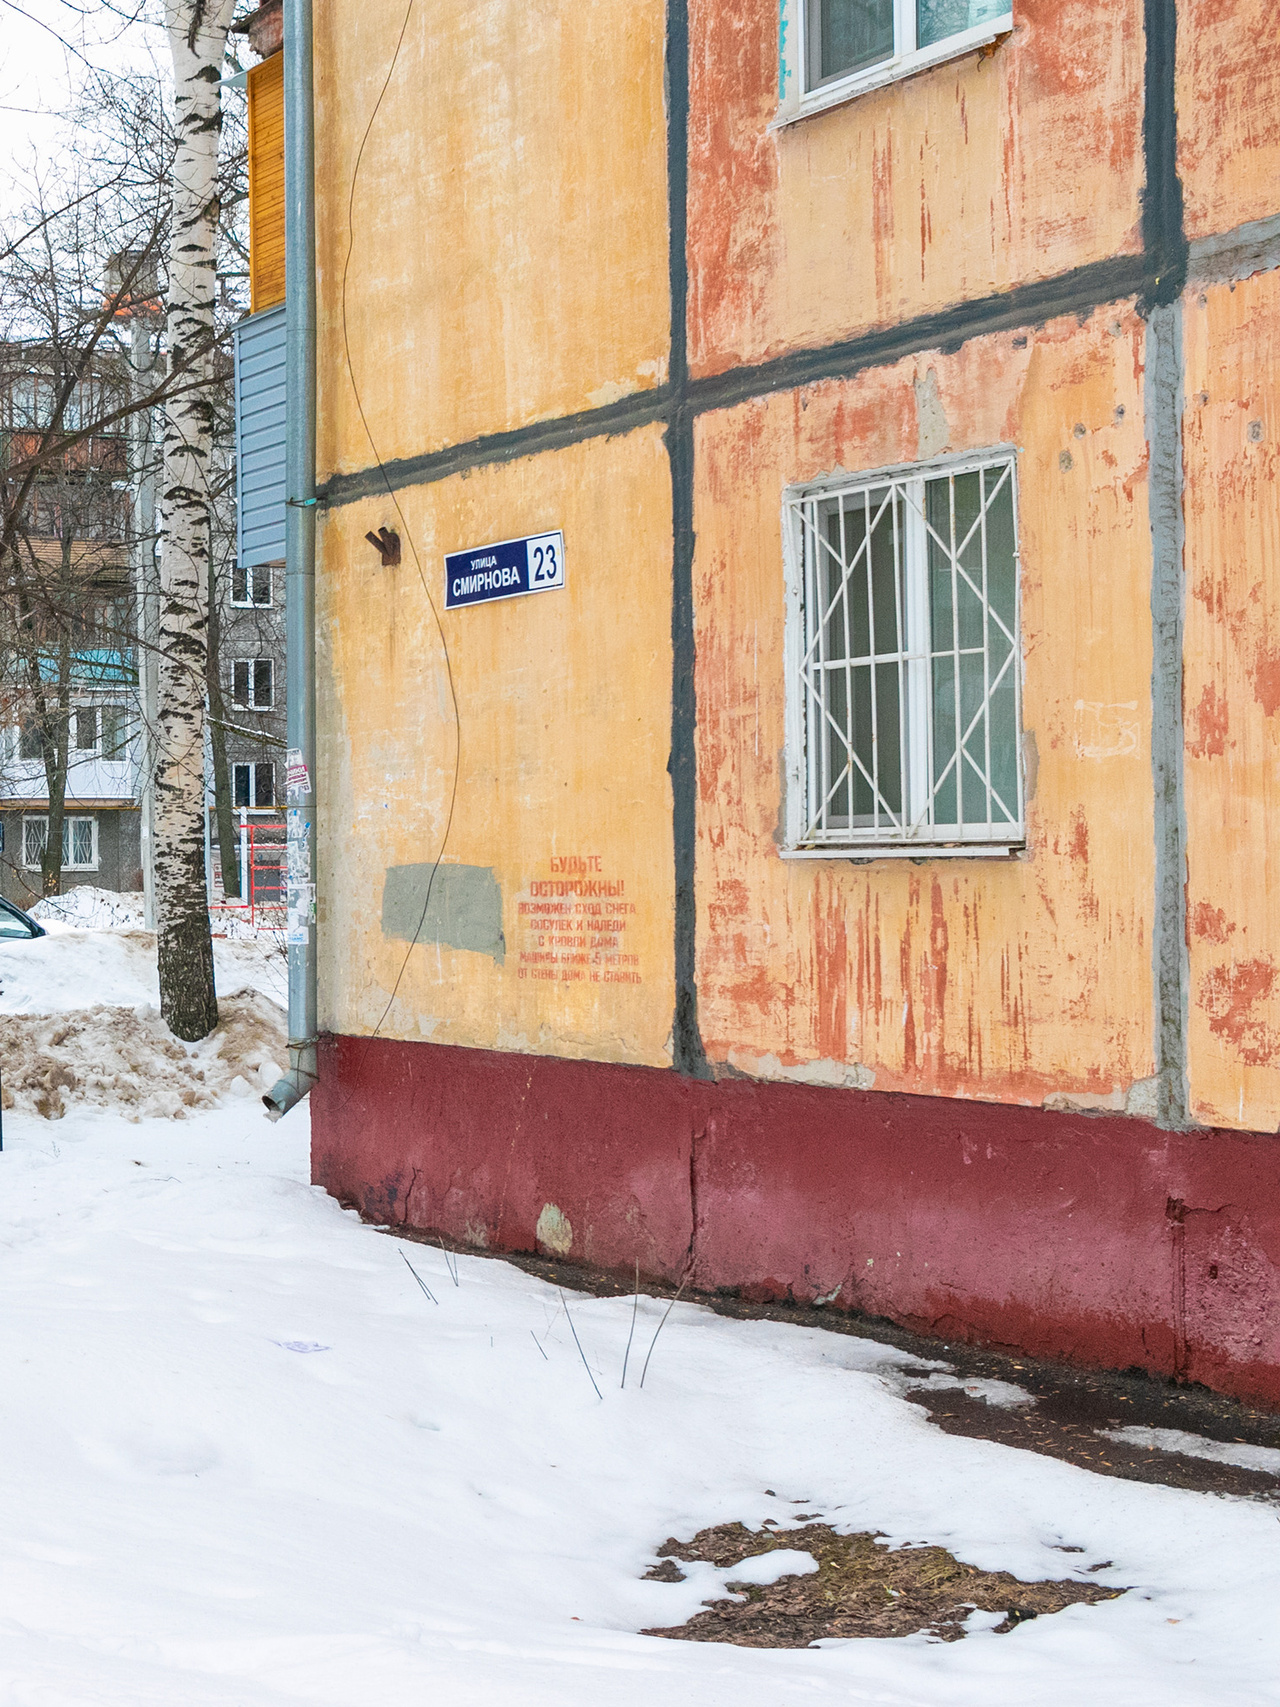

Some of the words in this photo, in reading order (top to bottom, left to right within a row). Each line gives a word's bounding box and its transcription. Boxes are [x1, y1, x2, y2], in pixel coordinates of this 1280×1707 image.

[470, 555, 498, 570] УЛИЦА
[533, 544, 558, 583] 23
[453, 566, 522, 597] СМИРНОВА
[550, 855, 602, 875] БУДЬТЕ
[530, 880, 624, 897] ОСТОРОЖНЫ!
[518, 902, 572, 915] ВОЗМОЖЕН
[574, 903, 602, 916] СХОД
[605, 903, 636, 915] СНЕГА
[530, 919, 573, 931] СОСУЛЕК
[576, 919, 583, 931] И
[587, 920, 626, 932] НАЛЕДИ
[538, 935, 545, 947] С
[548, 935, 586, 948] КРОВЛИ
[590, 936, 619, 949] ДОМА
[593, 952, 601, 965] 5
[605, 953, 639, 966] МЕТРОВ
[517, 968, 527, 979] ОТ
[561, 969, 585, 982] ДОМА
[590, 970, 600, 983] НЕ
[603, 970, 642, 984] СТАВИТЬ
